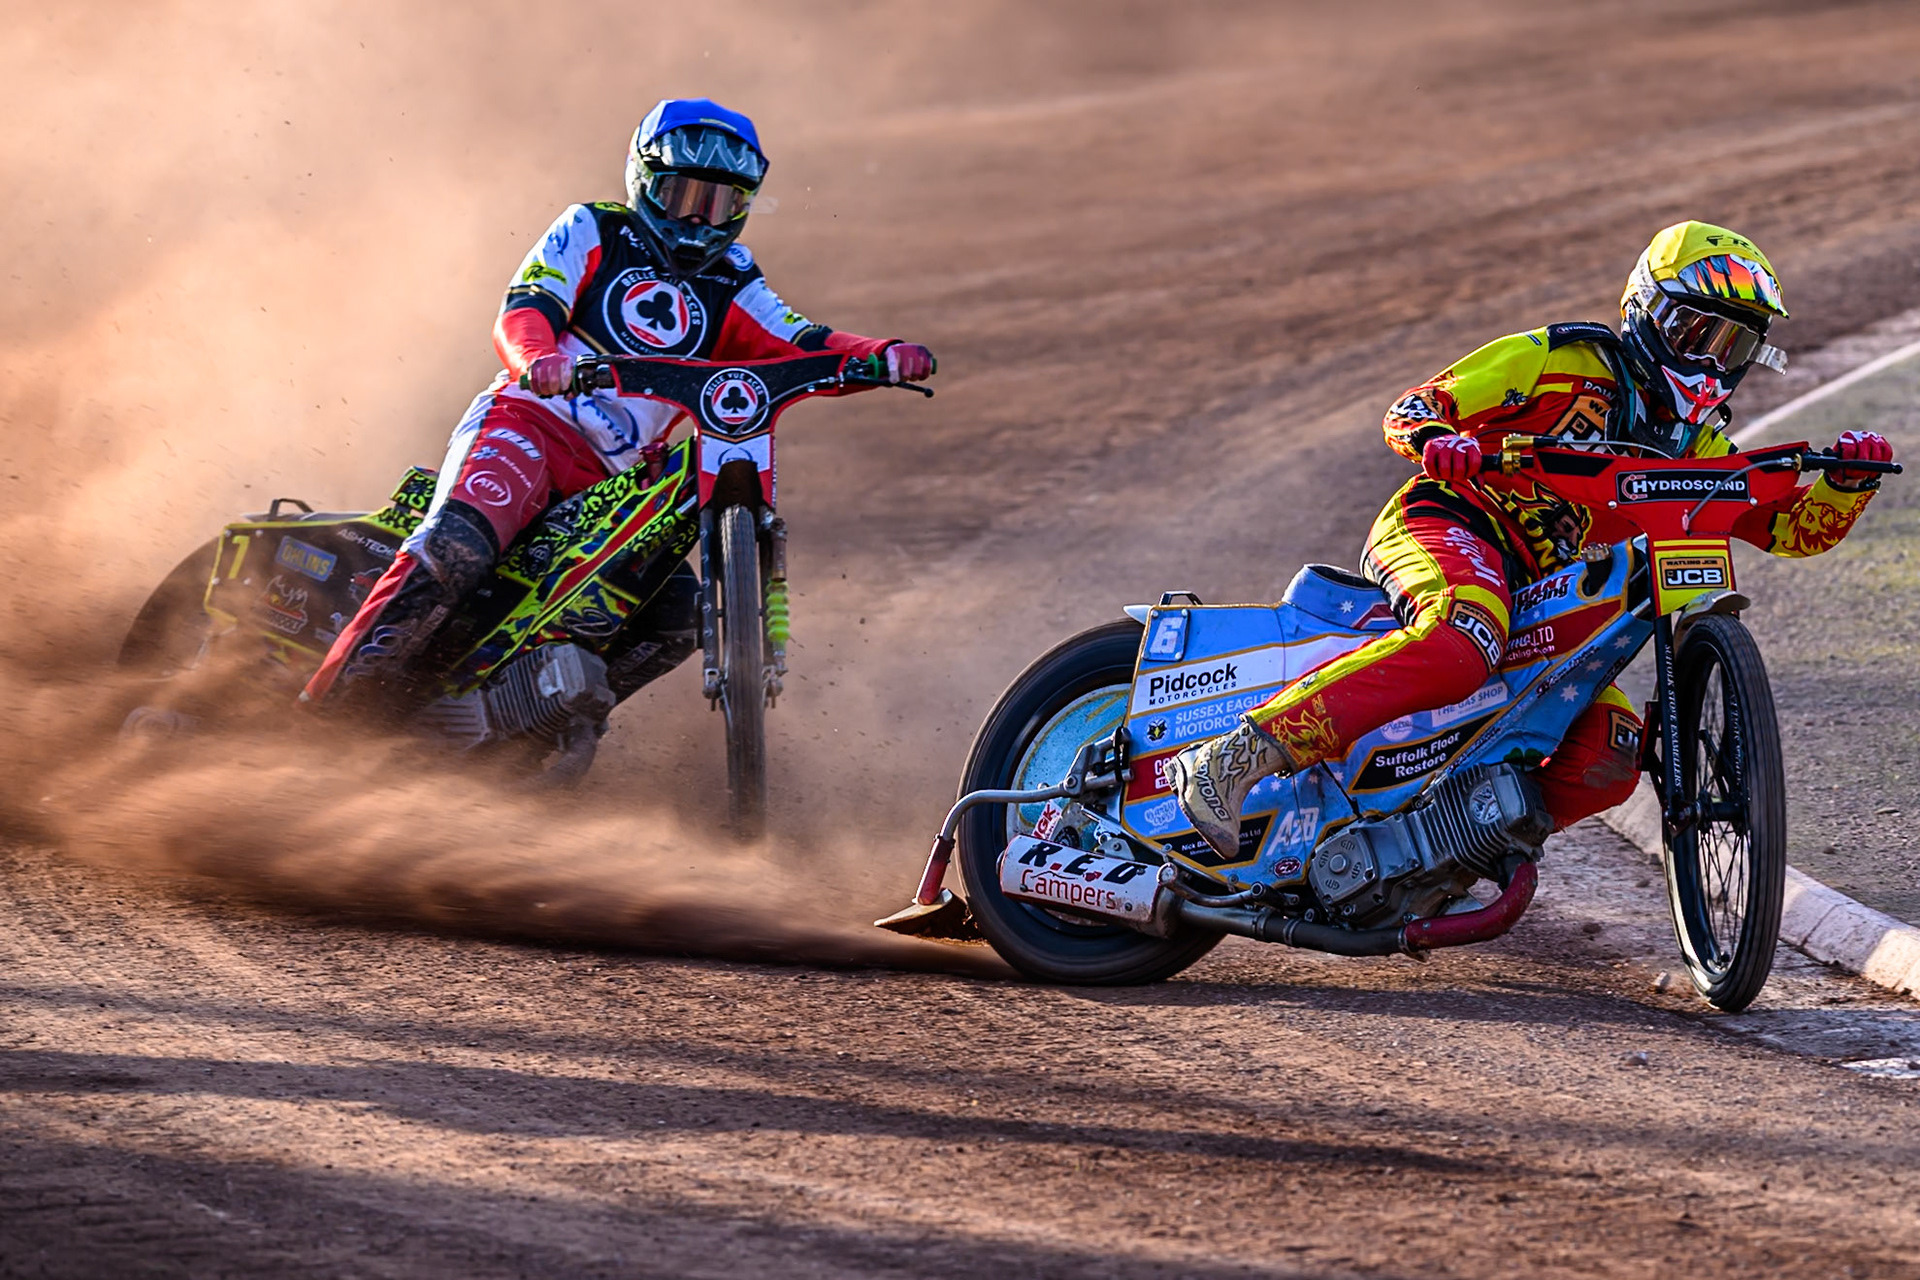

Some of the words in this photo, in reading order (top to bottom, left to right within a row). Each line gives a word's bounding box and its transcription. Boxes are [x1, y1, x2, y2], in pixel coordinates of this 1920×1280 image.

[621, 270, 657, 287] BELLE
[685, 295, 702, 326] ACES
[1632, 479, 1746, 494] HYDROSCAND
[1666, 569, 1722, 585] JCB
[1150, 616, 1184, 654] 6
[1455, 617, 1501, 665] JCB
[1149, 681, 1237, 706] MOTORCYCLES
[1150, 663, 1238, 697] Pidcock
[1478, 686, 1504, 702] SHOP
[1174, 714, 1240, 739] MOTORCY
[1175, 702, 1224, 725] SUSSEX
[1375, 744, 1427, 768] Suffolk
[1430, 731, 1461, 755] Floor
[1395, 752, 1448, 779] Restore
[1021, 869, 1117, 911] Campers
